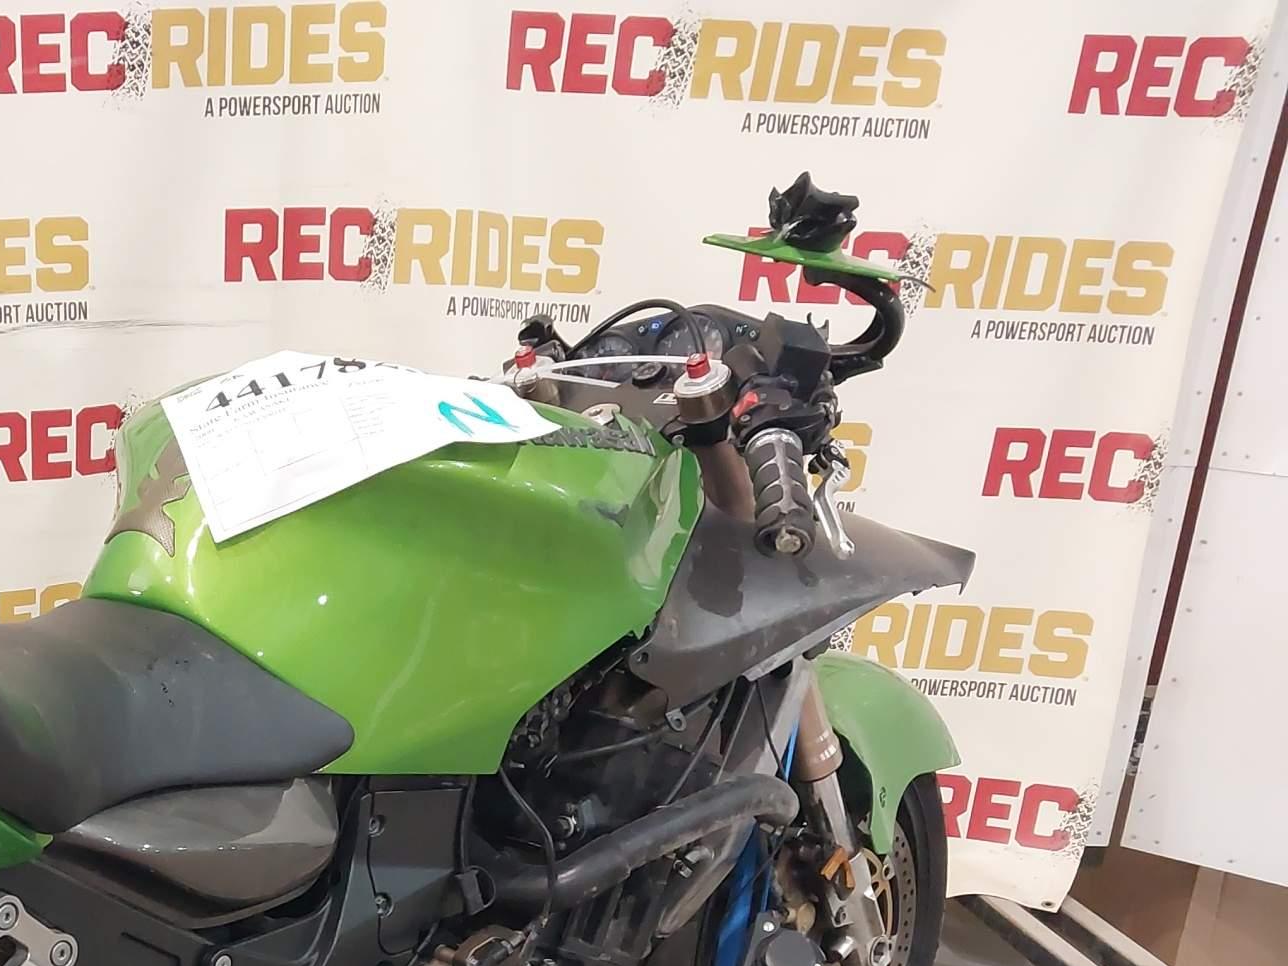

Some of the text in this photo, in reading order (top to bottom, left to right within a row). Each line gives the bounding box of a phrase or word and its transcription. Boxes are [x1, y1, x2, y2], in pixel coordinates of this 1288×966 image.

[151, 1, 386, 88] RIDES
[507, 11, 945, 107] REC RIDES
[1069, 35, 1249, 117] REC
[204, 92, 381, 118] A POWERSPORT AUCTION
[740, 112, 931, 140] A POWERSPORT AUCTION
[225, 208, 604, 293] REC RIDES
[924, 233, 1174, 316] RIDES
[25, 301, 88, 328] AUCTION
[446, 296, 457, 316] A
[461, 296, 530, 321] POWERSPORT
[970, 319, 1155, 346] A POWERSPORT AUCTION
[205, 356, 418, 412] 44178
[982, 428, 1157, 503] REC
[851, 602, 1094, 679] RIDES
[1008, 684, 1077, 706] AUCTION
[936, 774, 1079, 852] REC
